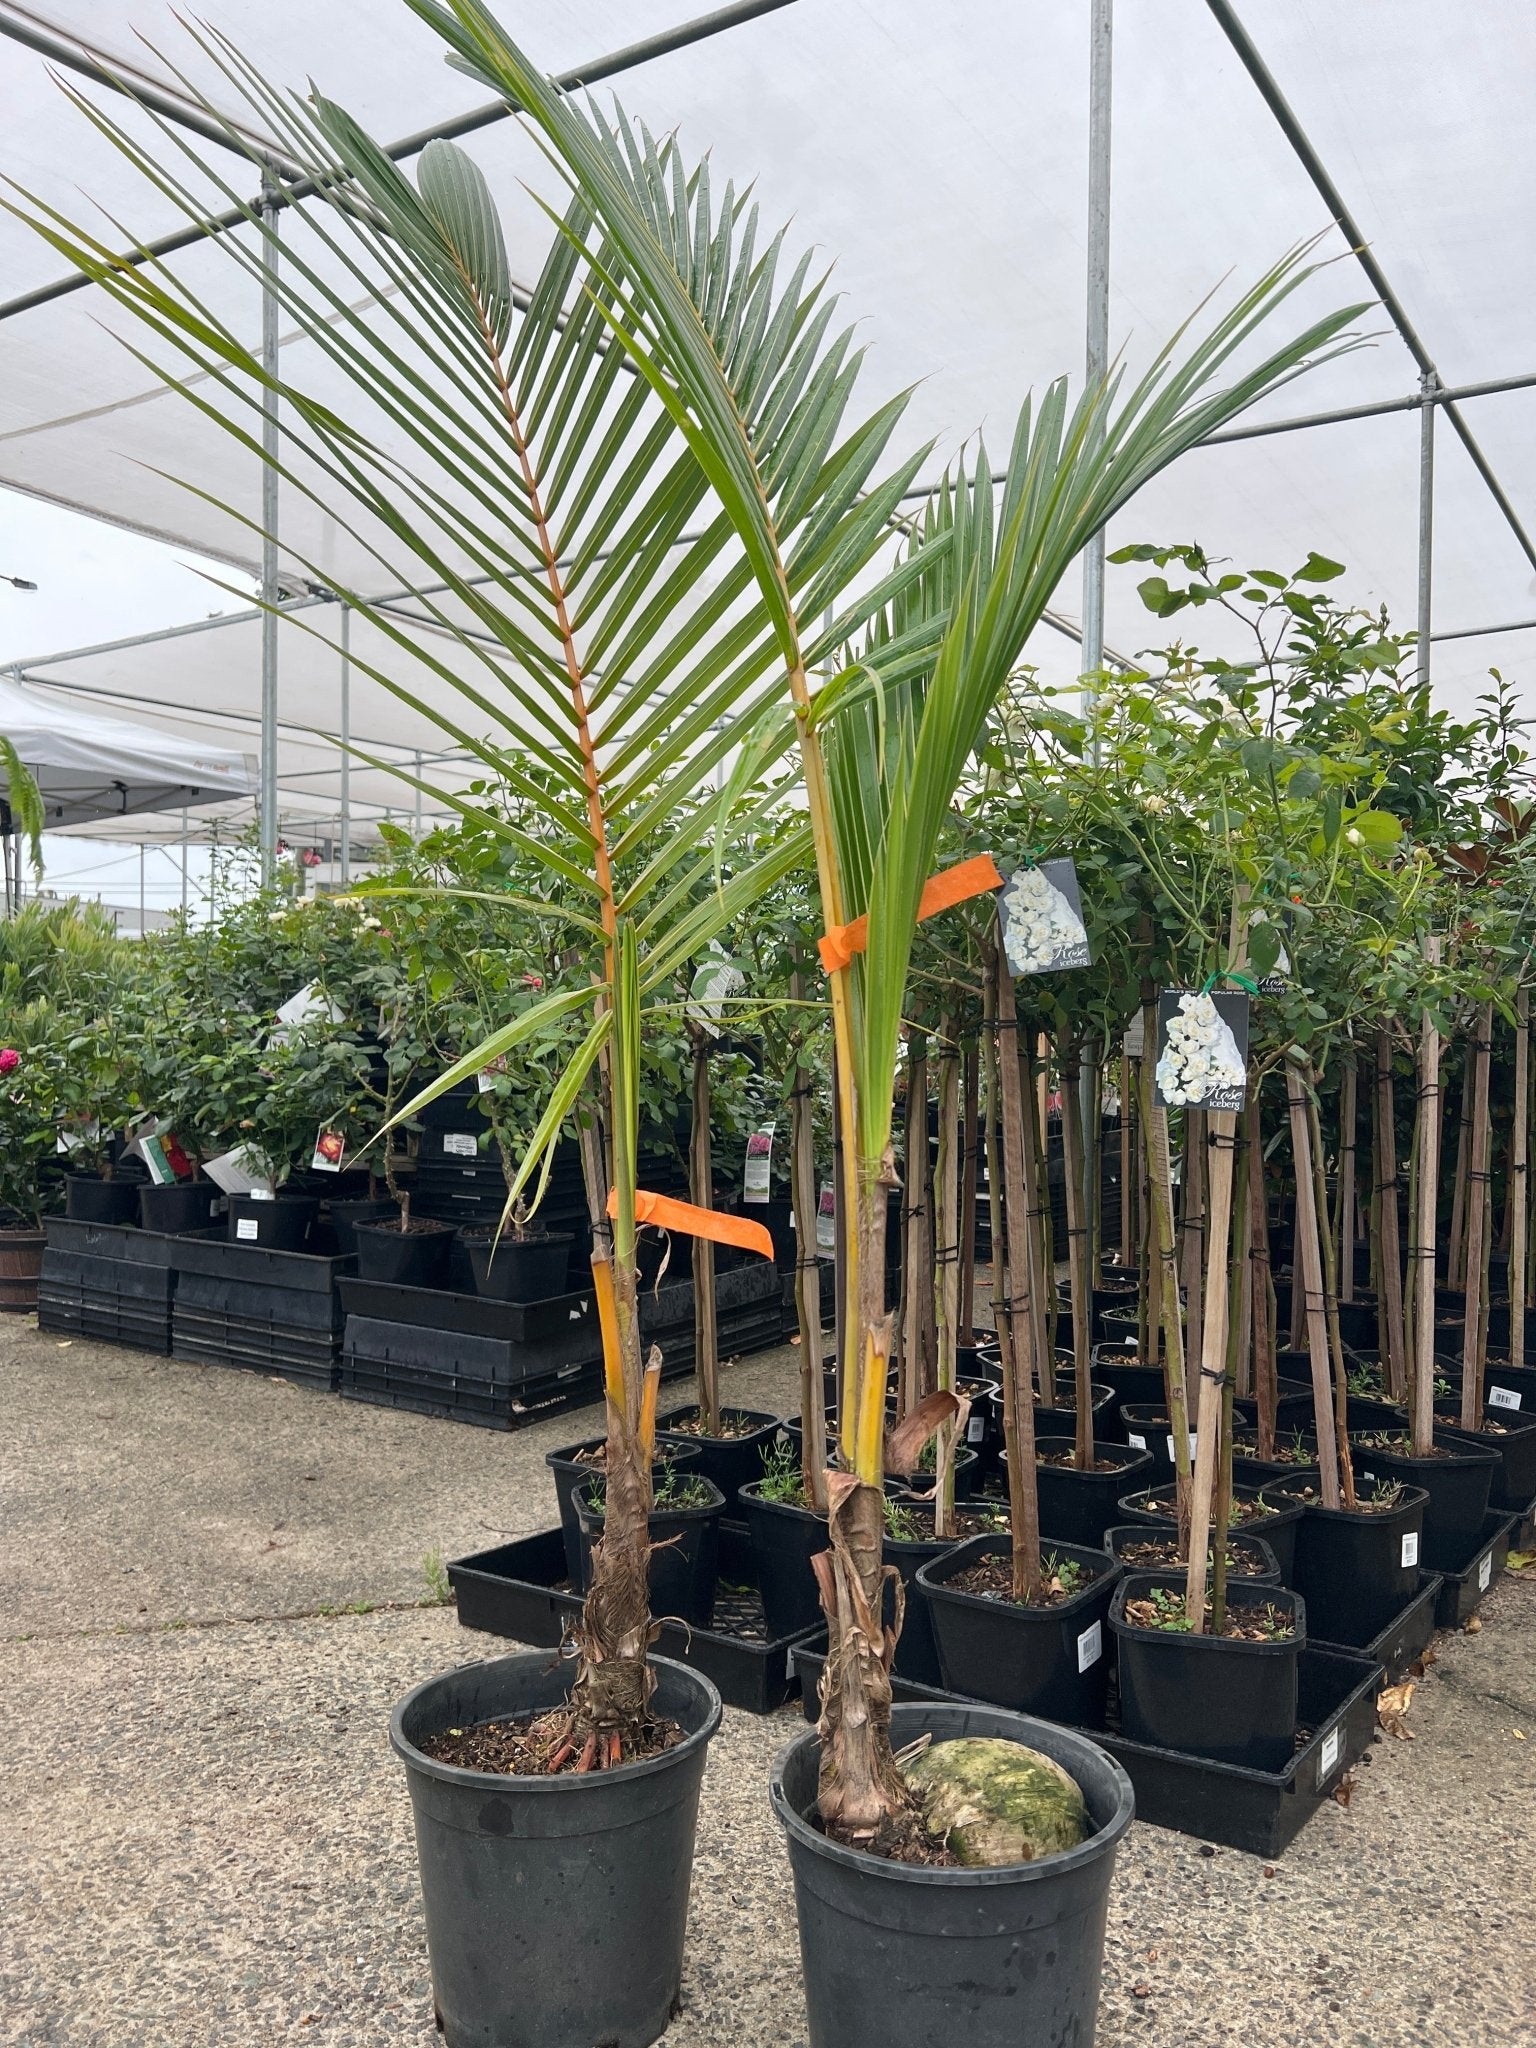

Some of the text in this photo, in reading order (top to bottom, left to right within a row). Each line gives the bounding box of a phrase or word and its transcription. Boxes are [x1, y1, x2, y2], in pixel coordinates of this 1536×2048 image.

[1051, 944, 1087, 961] Rose
[1201, 1081, 1243, 1101] Rose
[1209, 1098, 1241, 1111] iceberg
